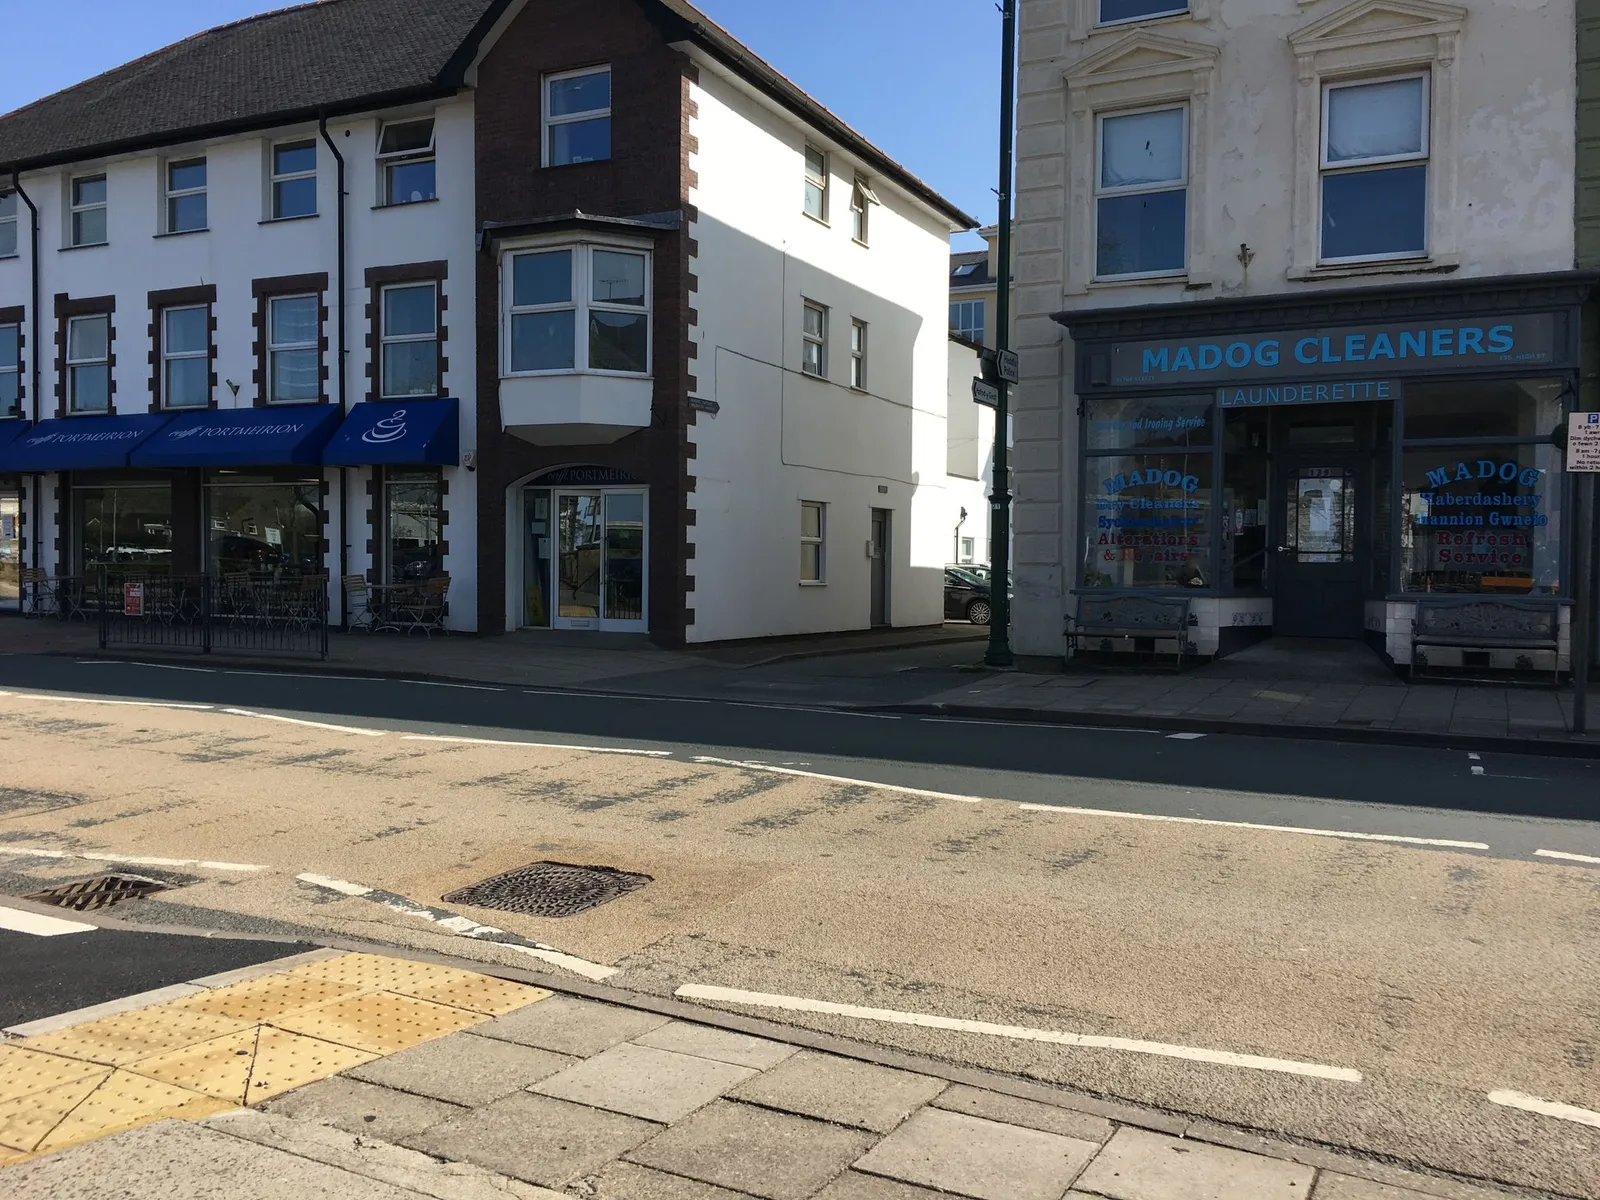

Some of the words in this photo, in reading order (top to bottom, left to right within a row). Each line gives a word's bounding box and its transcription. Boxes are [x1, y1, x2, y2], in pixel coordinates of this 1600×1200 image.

[1142, 340, 1280, 373] MADOG
[1294, 324, 1514, 364] CLEANERS
[1219, 381, 1391, 406] LAUNDERETTE
[1145, 417, 1173, 432] Ironing
[1175, 415, 1207, 428] Service
[1590, 414, 1599, 423] P
[52, 429, 144, 443] PORTMEIRION
[199, 423, 304, 437] PORTMEIRION
[1103, 467, 1200, 495] MADOG
[1424, 459, 1541, 489] MADOG
[1096, 498, 1124, 513] Dry
[1129, 496, 1200, 510] Cleaners
[1420, 492, 1542, 508] Haberdashery
[1098, 532, 1199, 546] Alterations
[1436, 530, 1526, 546] Refresh
[1103, 549, 1115, 561] &
[1438, 548, 1523, 564] Service
